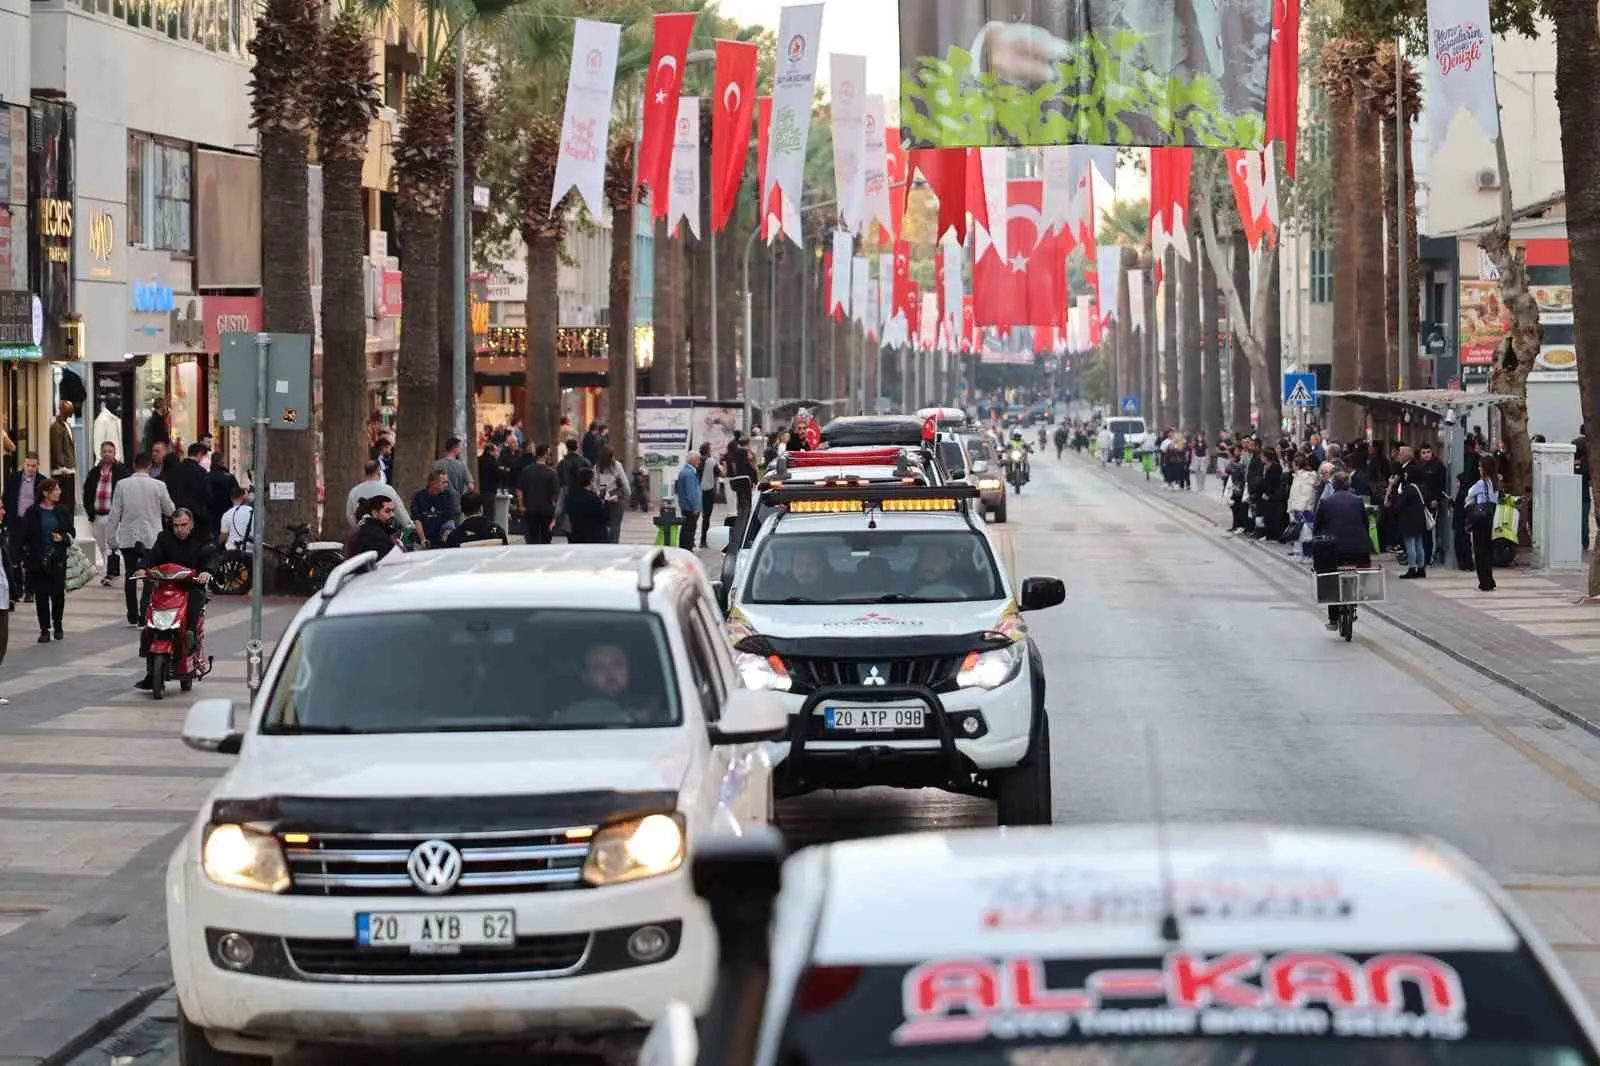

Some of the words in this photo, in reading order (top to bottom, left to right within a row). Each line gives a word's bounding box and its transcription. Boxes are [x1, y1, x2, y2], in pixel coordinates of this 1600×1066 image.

[44, 200, 73, 238] LORIS
[217, 313, 249, 334] GUSTO
[835, 711, 853, 726] 20
[861, 711, 887, 726] ATP
[895, 710, 921, 726] 098
[373, 917, 398, 940] 20
[421, 915, 461, 939] AYB
[483, 914, 509, 938] 62
[900, 950, 1466, 1018] AL-KAN
